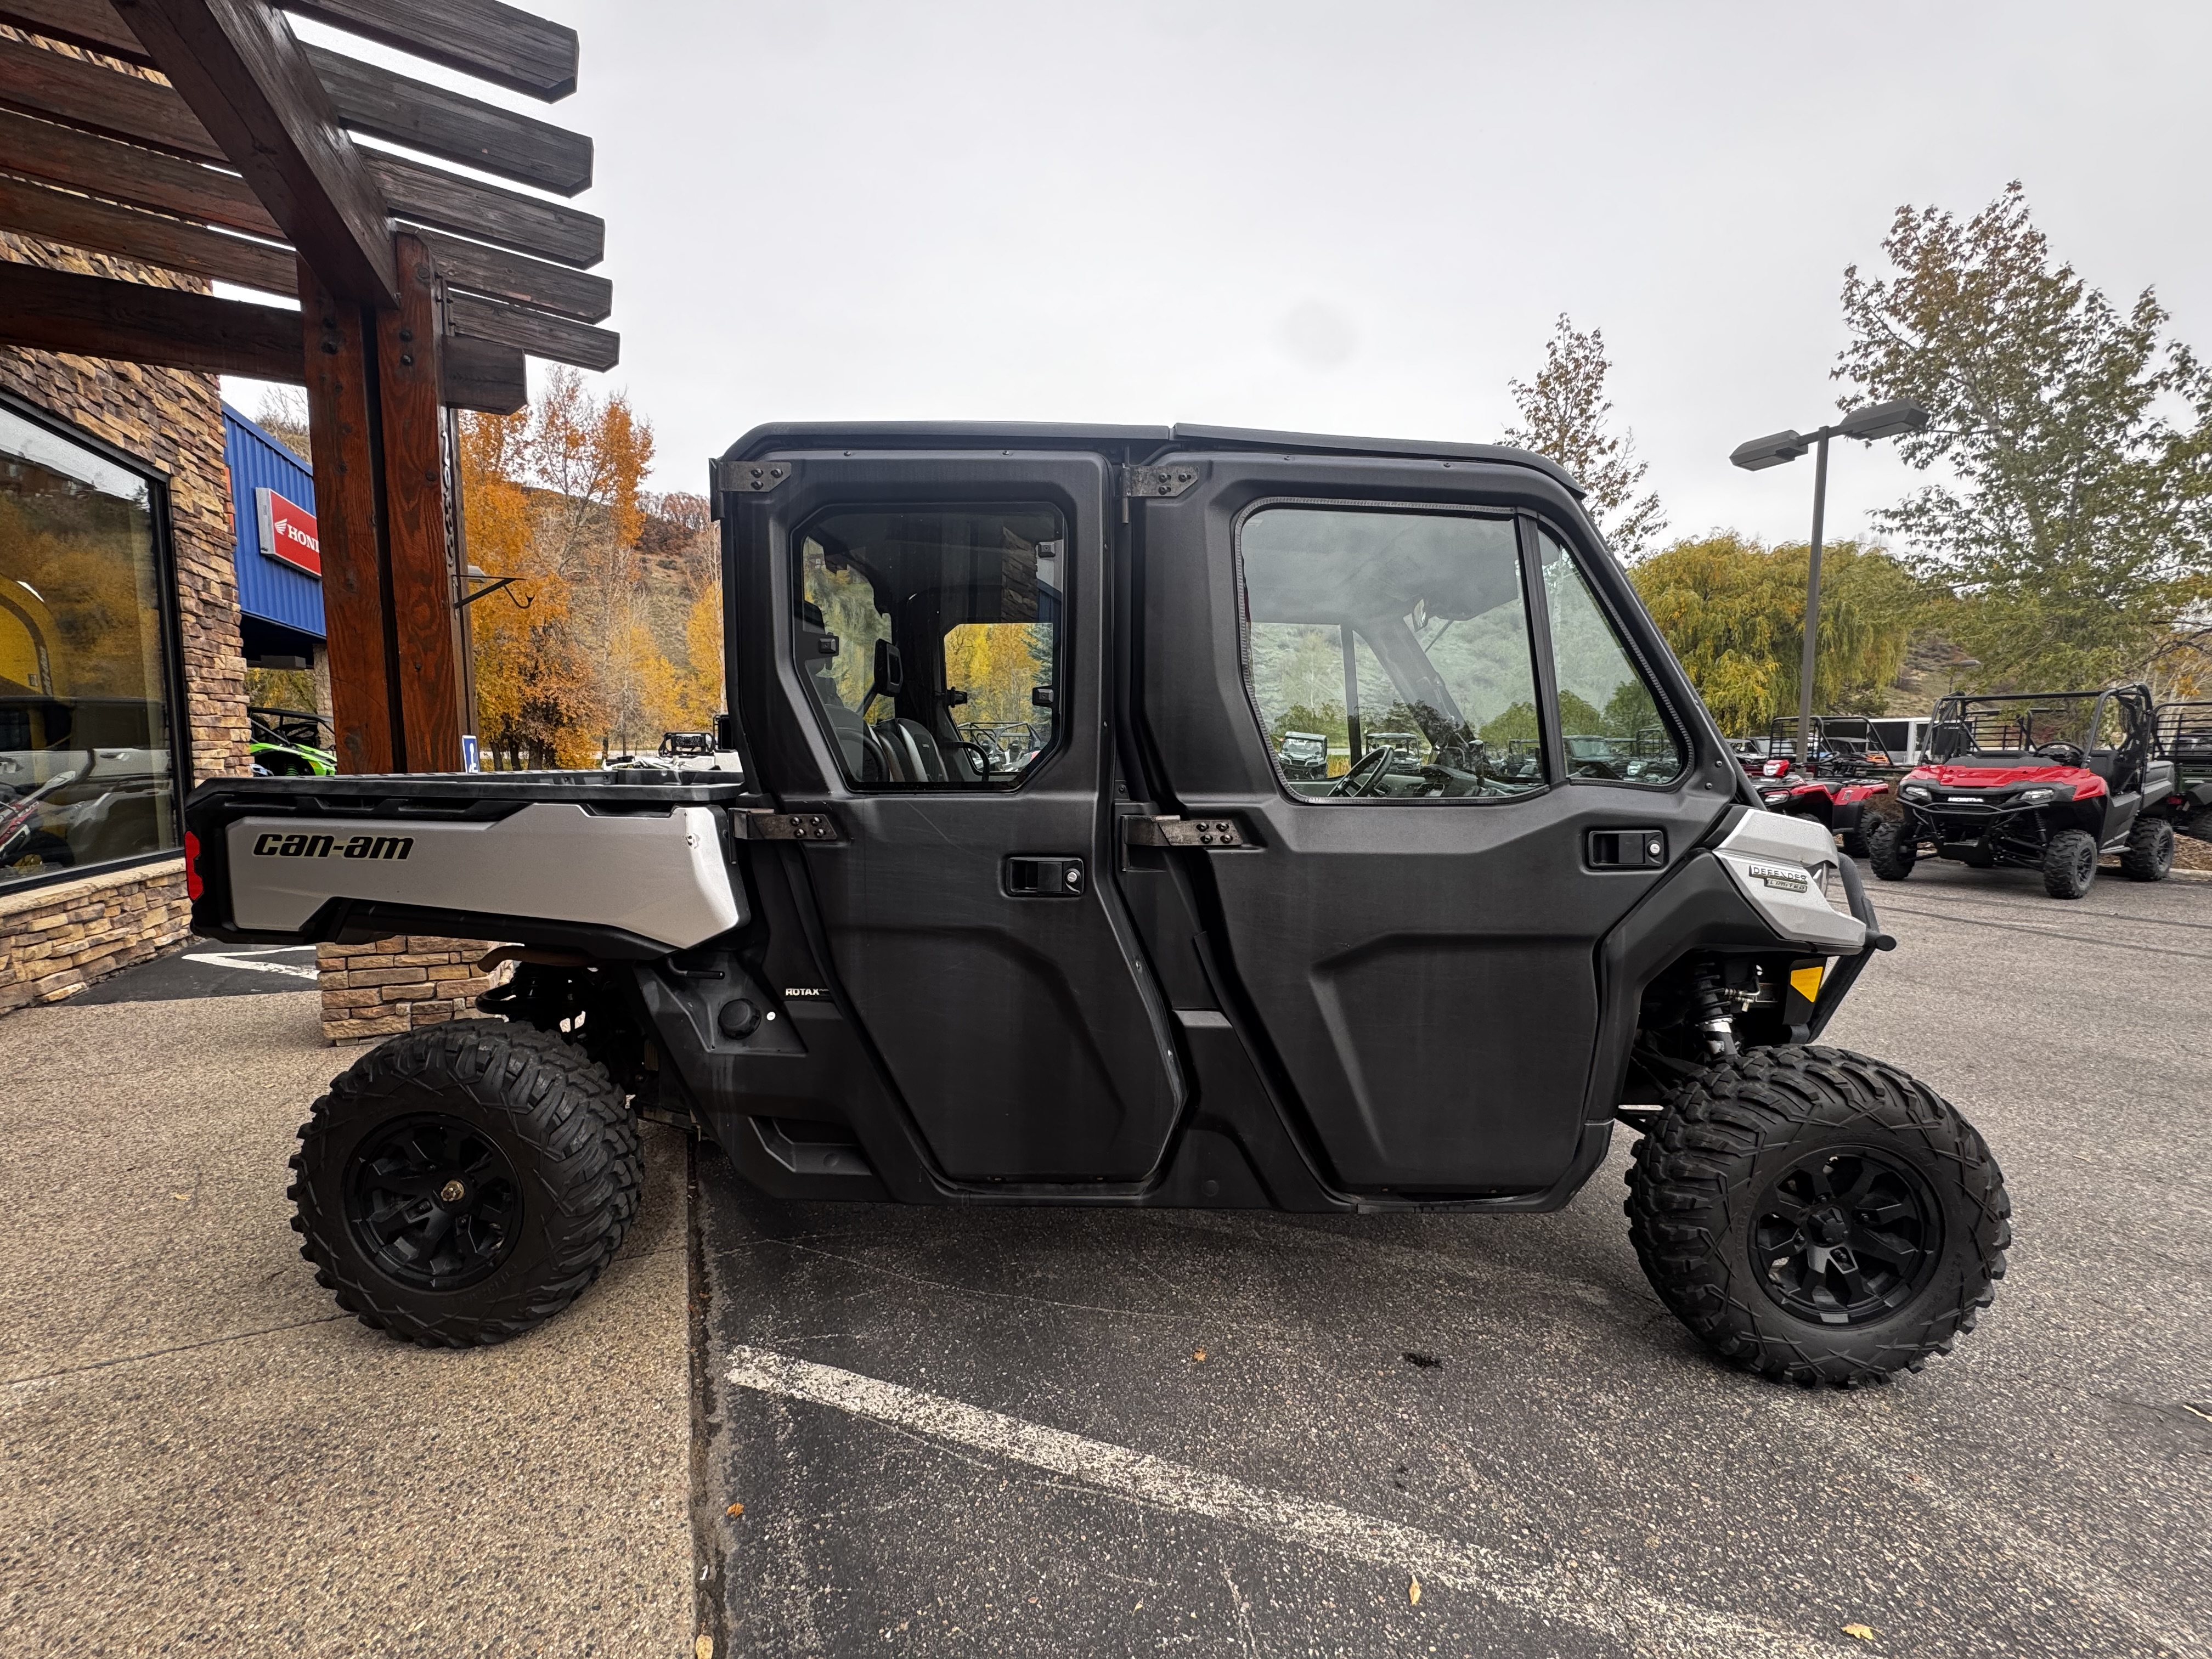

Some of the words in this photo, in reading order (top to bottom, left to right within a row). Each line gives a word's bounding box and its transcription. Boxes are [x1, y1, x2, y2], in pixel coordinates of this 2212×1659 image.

[253, 834, 414, 860] can-am
[1753, 867, 1807, 882] DEFENDER
[1770, 881, 1805, 890] LIMITED
